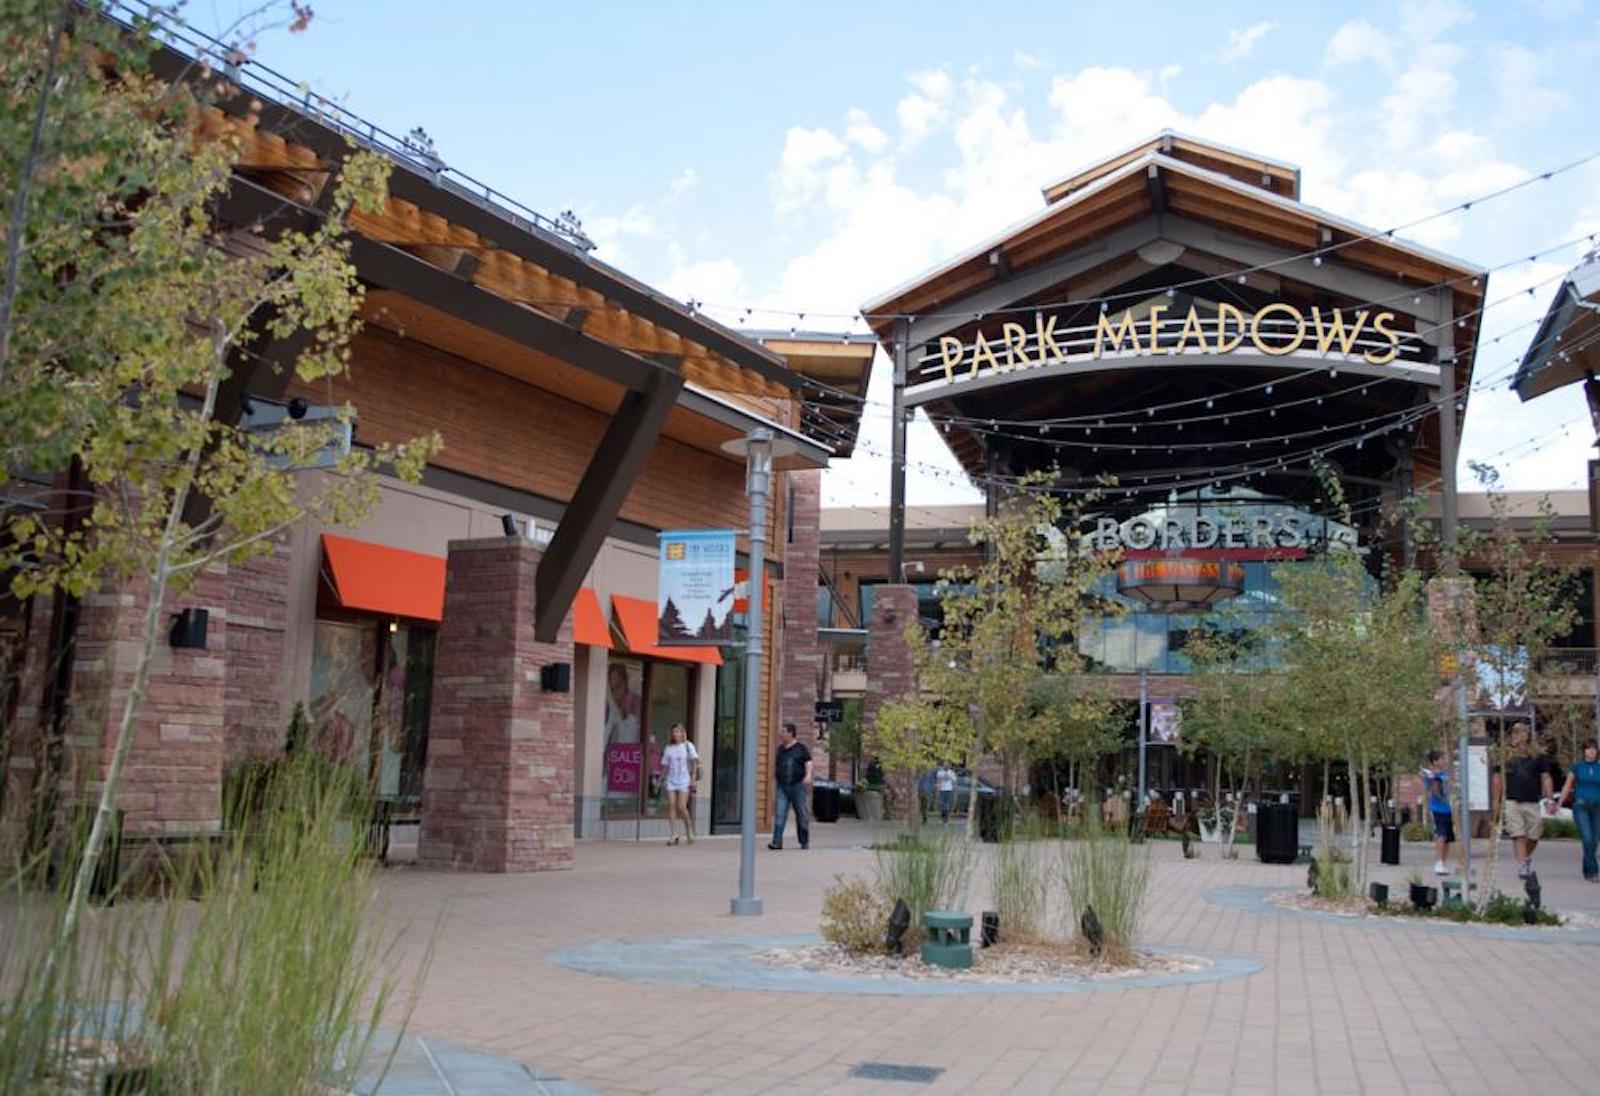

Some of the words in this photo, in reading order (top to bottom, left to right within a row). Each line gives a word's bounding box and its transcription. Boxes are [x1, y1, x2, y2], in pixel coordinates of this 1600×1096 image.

[940, 311, 1065, 384] PARK
[1093, 302, 1399, 365] MEADOWS
[1097, 515, 1301, 550] BORDERS
[609, 750, 641, 764] SALE
